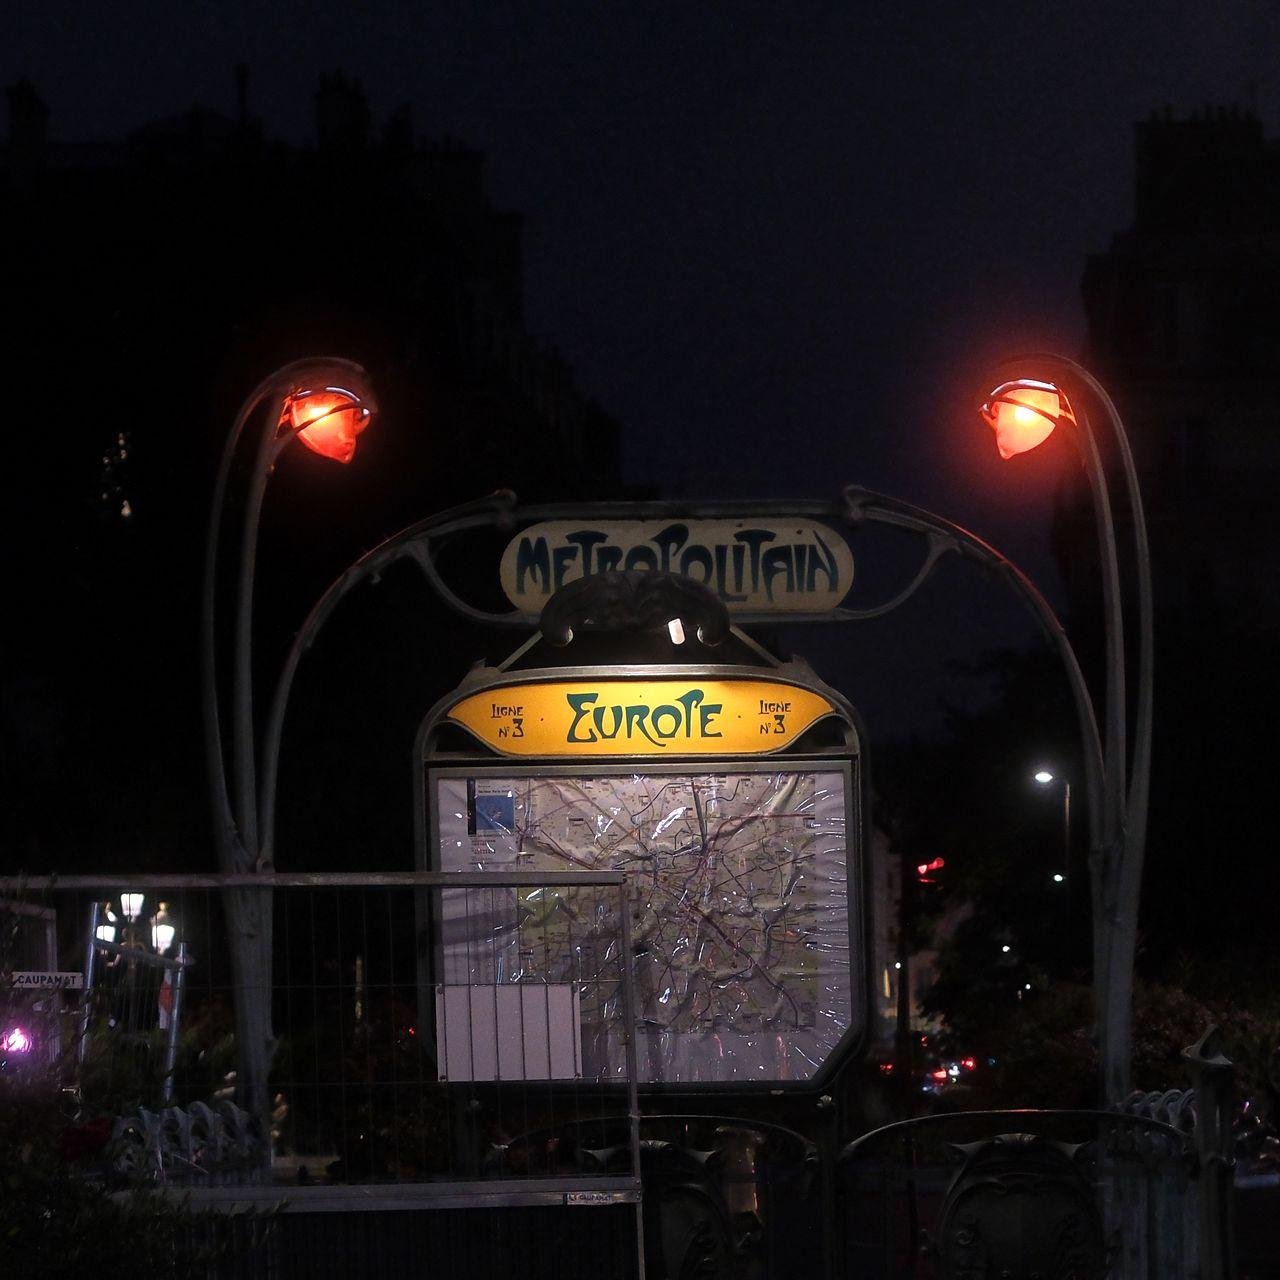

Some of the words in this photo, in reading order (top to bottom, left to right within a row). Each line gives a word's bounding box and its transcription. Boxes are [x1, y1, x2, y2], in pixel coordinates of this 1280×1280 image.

[516, 523, 839, 602] METROPOLITAIN
[490, 703, 524, 719] LIGNE
[758, 699, 792, 715] LIGNE
[512, 718, 524, 738] 3
[566, 689, 723, 747] EUROPE
[773, 714, 786, 734] 3
